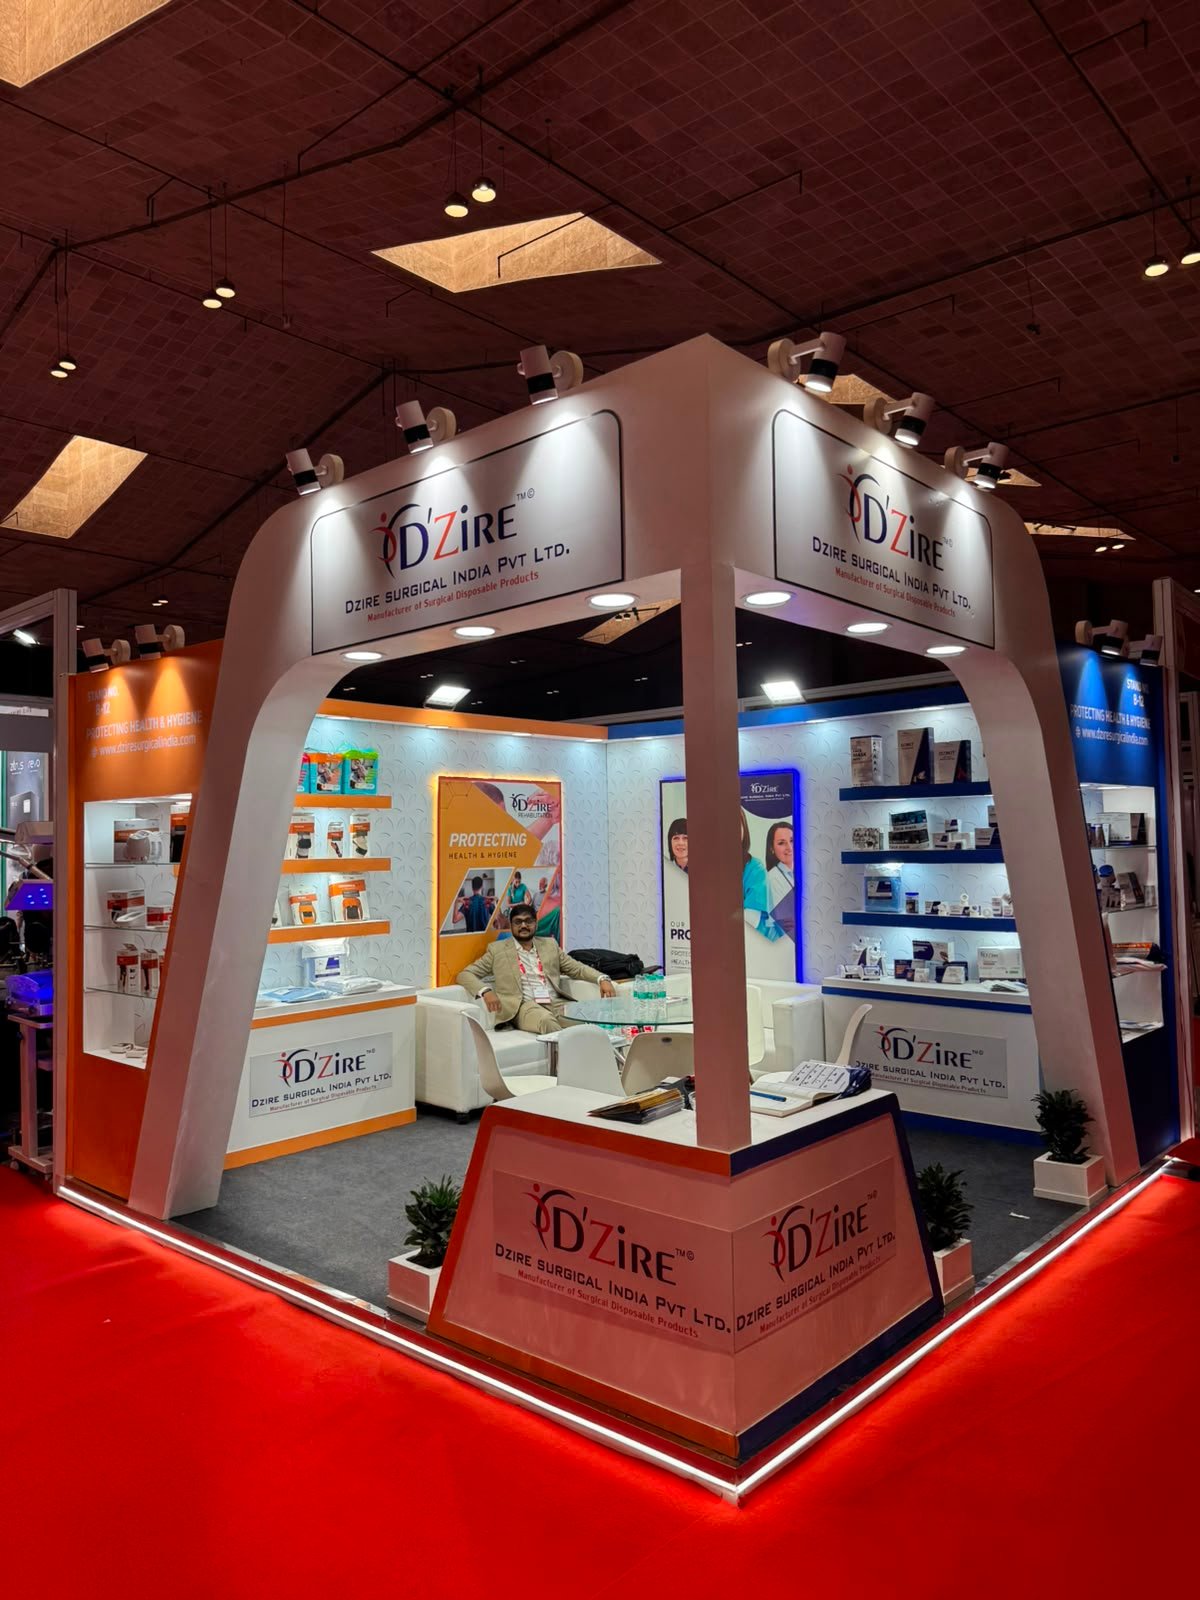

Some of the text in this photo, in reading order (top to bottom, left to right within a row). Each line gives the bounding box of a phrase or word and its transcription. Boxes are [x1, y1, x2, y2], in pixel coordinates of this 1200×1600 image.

[812, 536, 847, 562] DZIRE
[851, 553, 900, 583] SURGICAL
[904, 571, 929, 594] INDIA
[835, 567, 875, 590] Manufacturer
[345, 596, 380, 614] DZIRE
[385, 578, 447, 603] SURGICAL
[453, 565, 491, 585] INDIA
[367, 571, 539, 622] Manufacturer of Surgical Disposable Products
[87, 721, 130, 738] PROTECTING
[130, 717, 159, 735] HEALTH
[166, 711, 203, 728] HYGIENE
[449, 833, 527, 847] PROTECTING
[487, 851, 518, 859] HYGIENE
[882, 1065, 926, 1077] SURGICAL
[930, 1072, 956, 1082] INDIA
[251, 1096, 280, 1108] DZIRE
[283, 1087, 326, 1101] SURGICAL
[329, 1081, 352, 1092] INDIA
[495, 1243, 532, 1267] DZIRE
[537, 1259, 603, 1291] SURGICAL
[609, 1280, 649, 1306] INDIA
[518, 1270, 699, 1339] Manufacturer of Surgical Disposable Products
[735, 1302, 772, 1332] DZIRE
[775, 1272, 826, 1309] SURGICAL
[829, 1256, 854, 1278] INDIA
